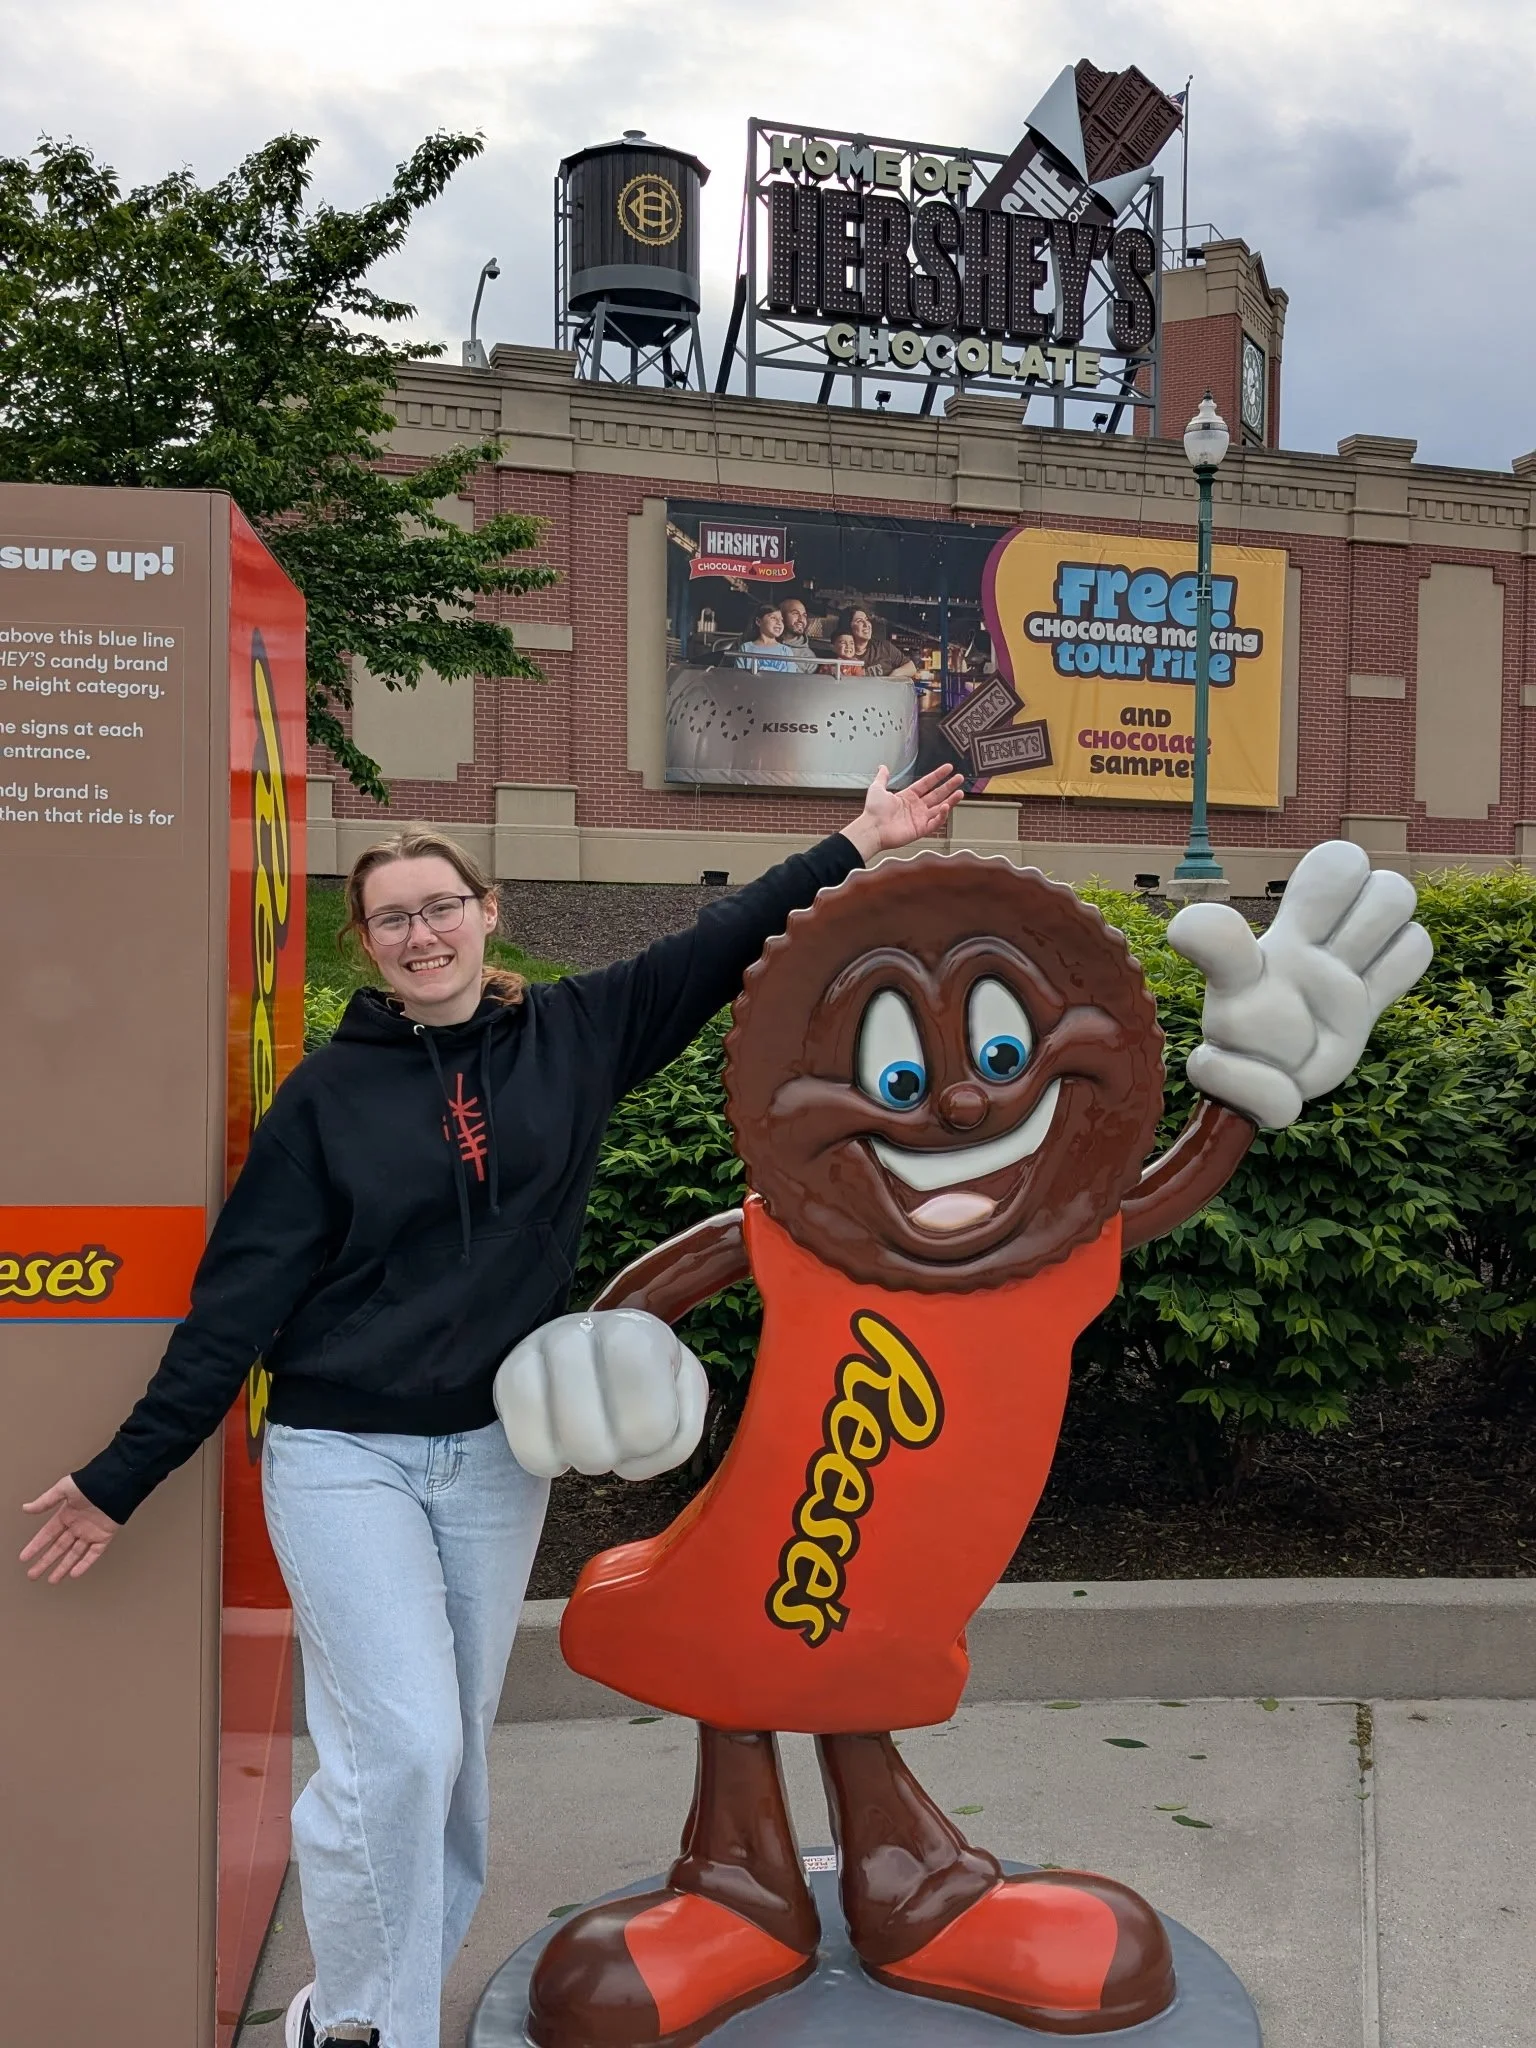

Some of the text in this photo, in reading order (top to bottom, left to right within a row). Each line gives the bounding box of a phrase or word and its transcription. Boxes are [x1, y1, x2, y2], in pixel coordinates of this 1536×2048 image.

[1102, 73, 1146, 128] HERSHEY'S
[1131, 104, 1175, 157] HERSHEY'S
[770, 134, 974, 195] HOME OF
[768, 181, 1157, 351] HERSHEY'S
[825, 323, 1100, 388] CHOCOLATE
[707, 530, 779, 559] HERSHEY'S
[0, 546, 174, 581] sure up!
[697, 562, 788, 577] CHOCOLATE WORLD
[1058, 566, 1233, 629] Free!
[0, 628, 175, 648] above this blue line
[50, 654, 108, 673] candy
[114, 655, 168, 672] brand
[1056, 641, 1146, 676] tour
[13, 676, 71, 696] height
[76, 680, 165, 699] category.
[21, 719, 69, 739] signs
[74, 723, 94, 736] at
[99, 722, 144, 738] each
[3, 745, 91, 760] entrance.
[980, 735, 1040, 762] HERSHEY'S
[34, 782, 89, 799] brand
[94, 784, 109, 800] is
[0, 806, 174, 825] then that ride is for
[769, 1312, 941, 1645] Reese's
